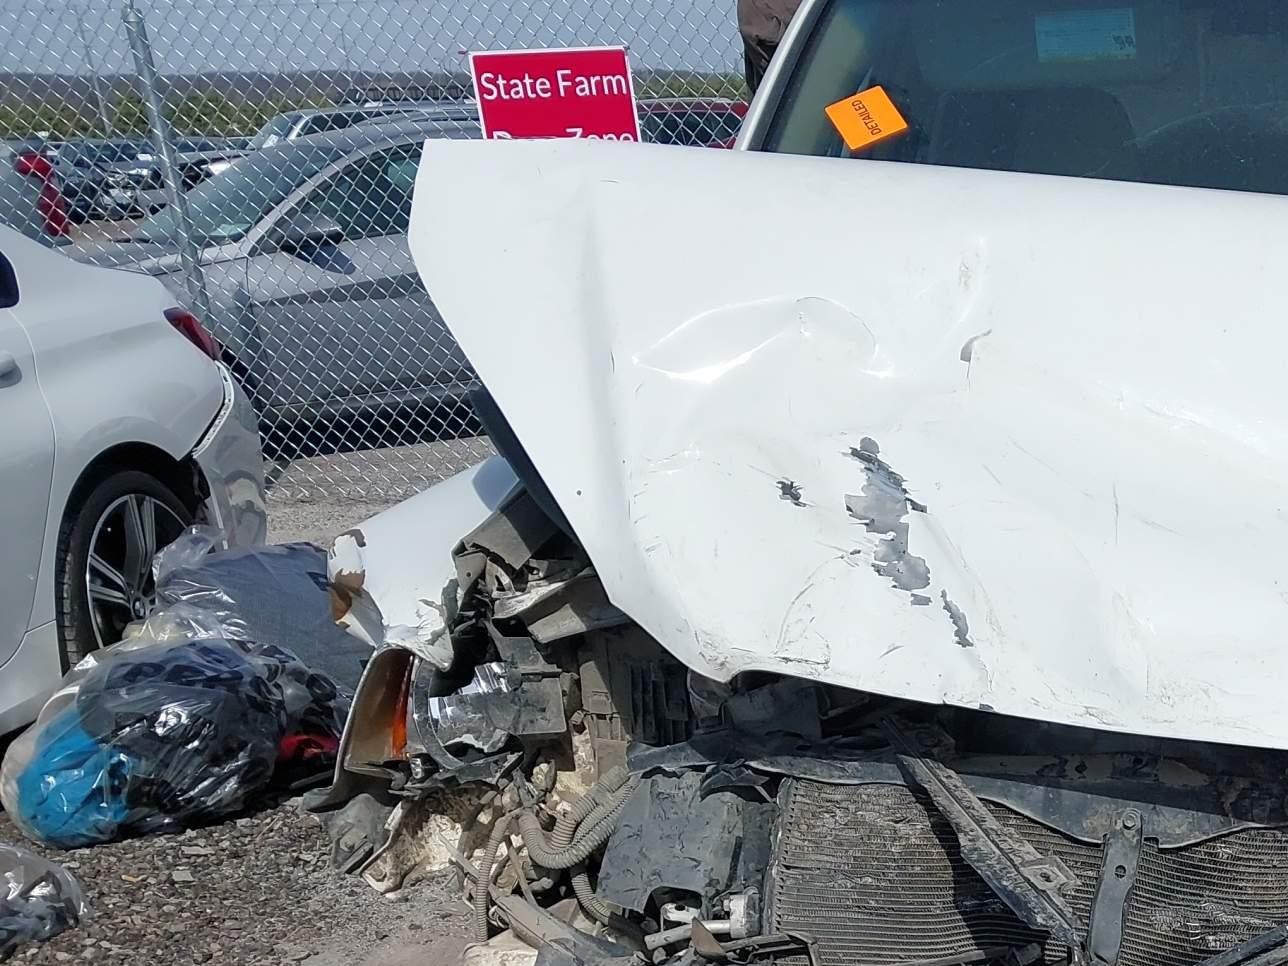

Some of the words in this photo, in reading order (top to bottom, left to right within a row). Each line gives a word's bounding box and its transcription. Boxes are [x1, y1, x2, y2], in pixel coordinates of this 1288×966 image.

[480, 72, 551, 100] State
[556, 69, 627, 97] Farm
[851, 99, 882, 136] DETAILED
